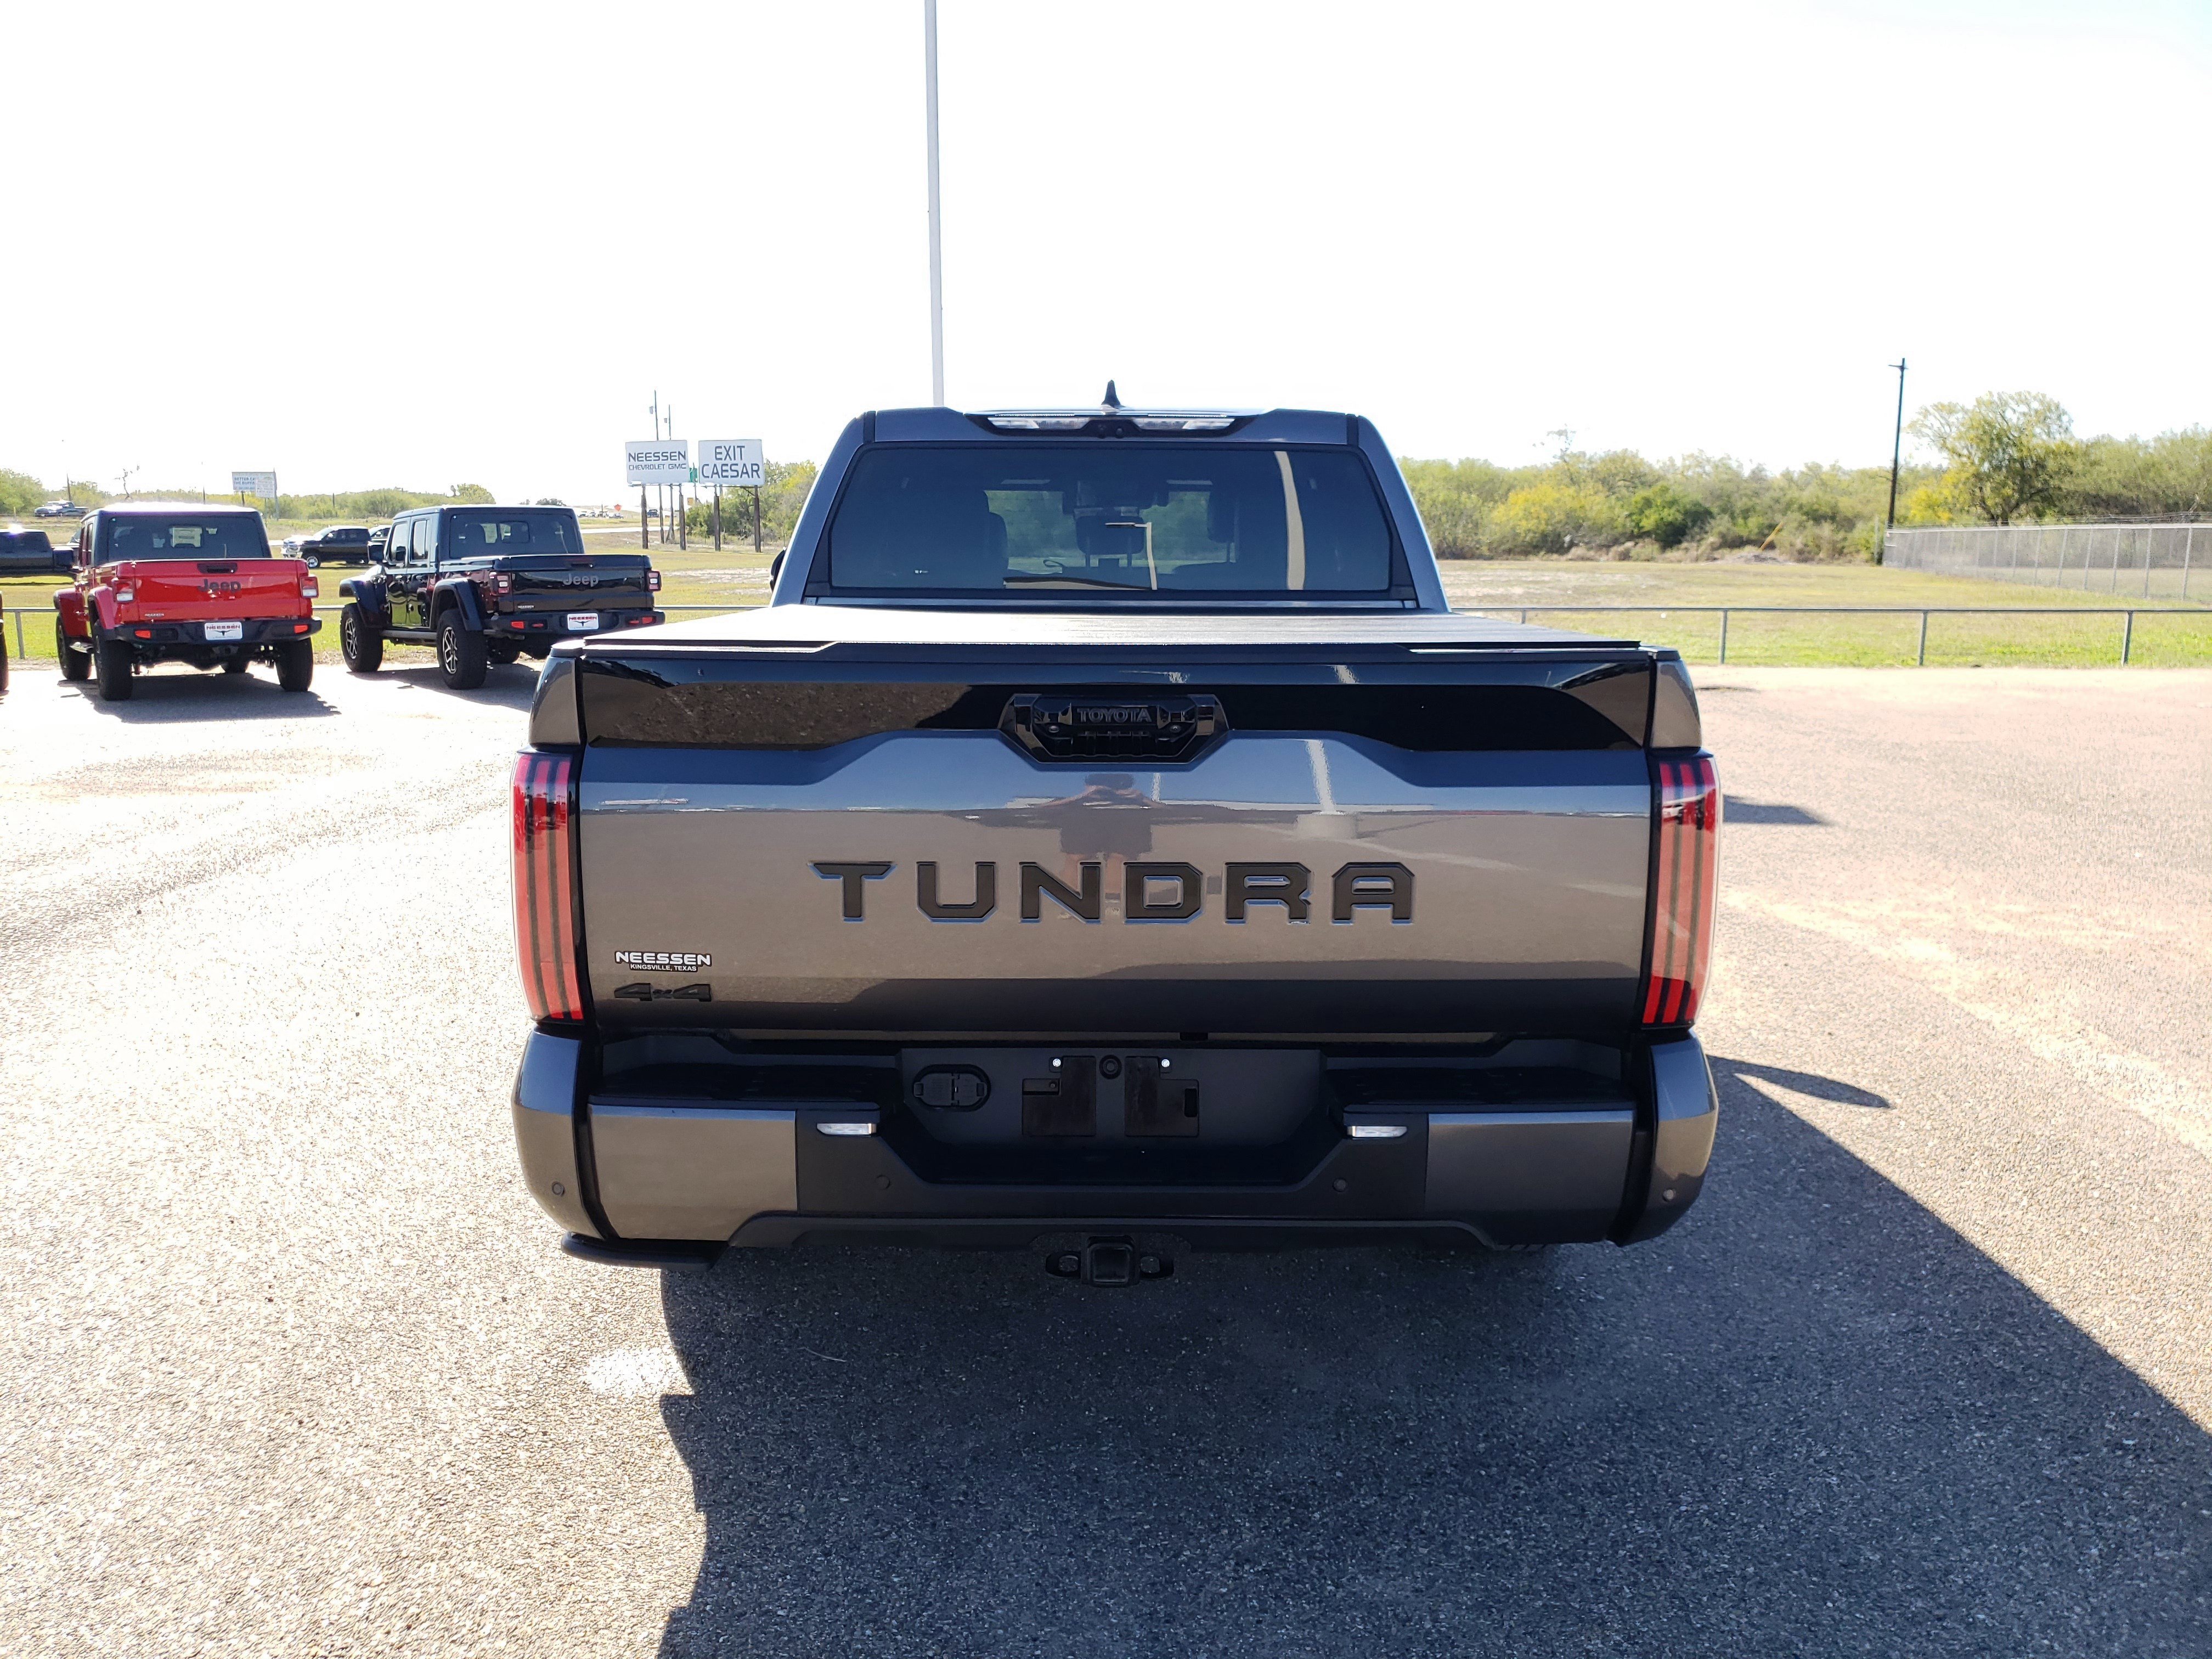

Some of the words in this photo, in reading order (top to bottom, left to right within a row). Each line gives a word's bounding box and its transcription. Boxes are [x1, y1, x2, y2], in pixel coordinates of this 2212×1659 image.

[628, 450, 686, 462] NEESSEN
[715, 445, 745, 461] EXIT
[702, 464, 760, 478] CAESAR
[198, 579, 241, 593] Jeep
[563, 573, 599, 587] Jeep
[1077, 708, 1152, 723] TOYOTA
[809, 861, 1415, 924] TUNDRA
[616, 951, 711, 966] NEESSEN
